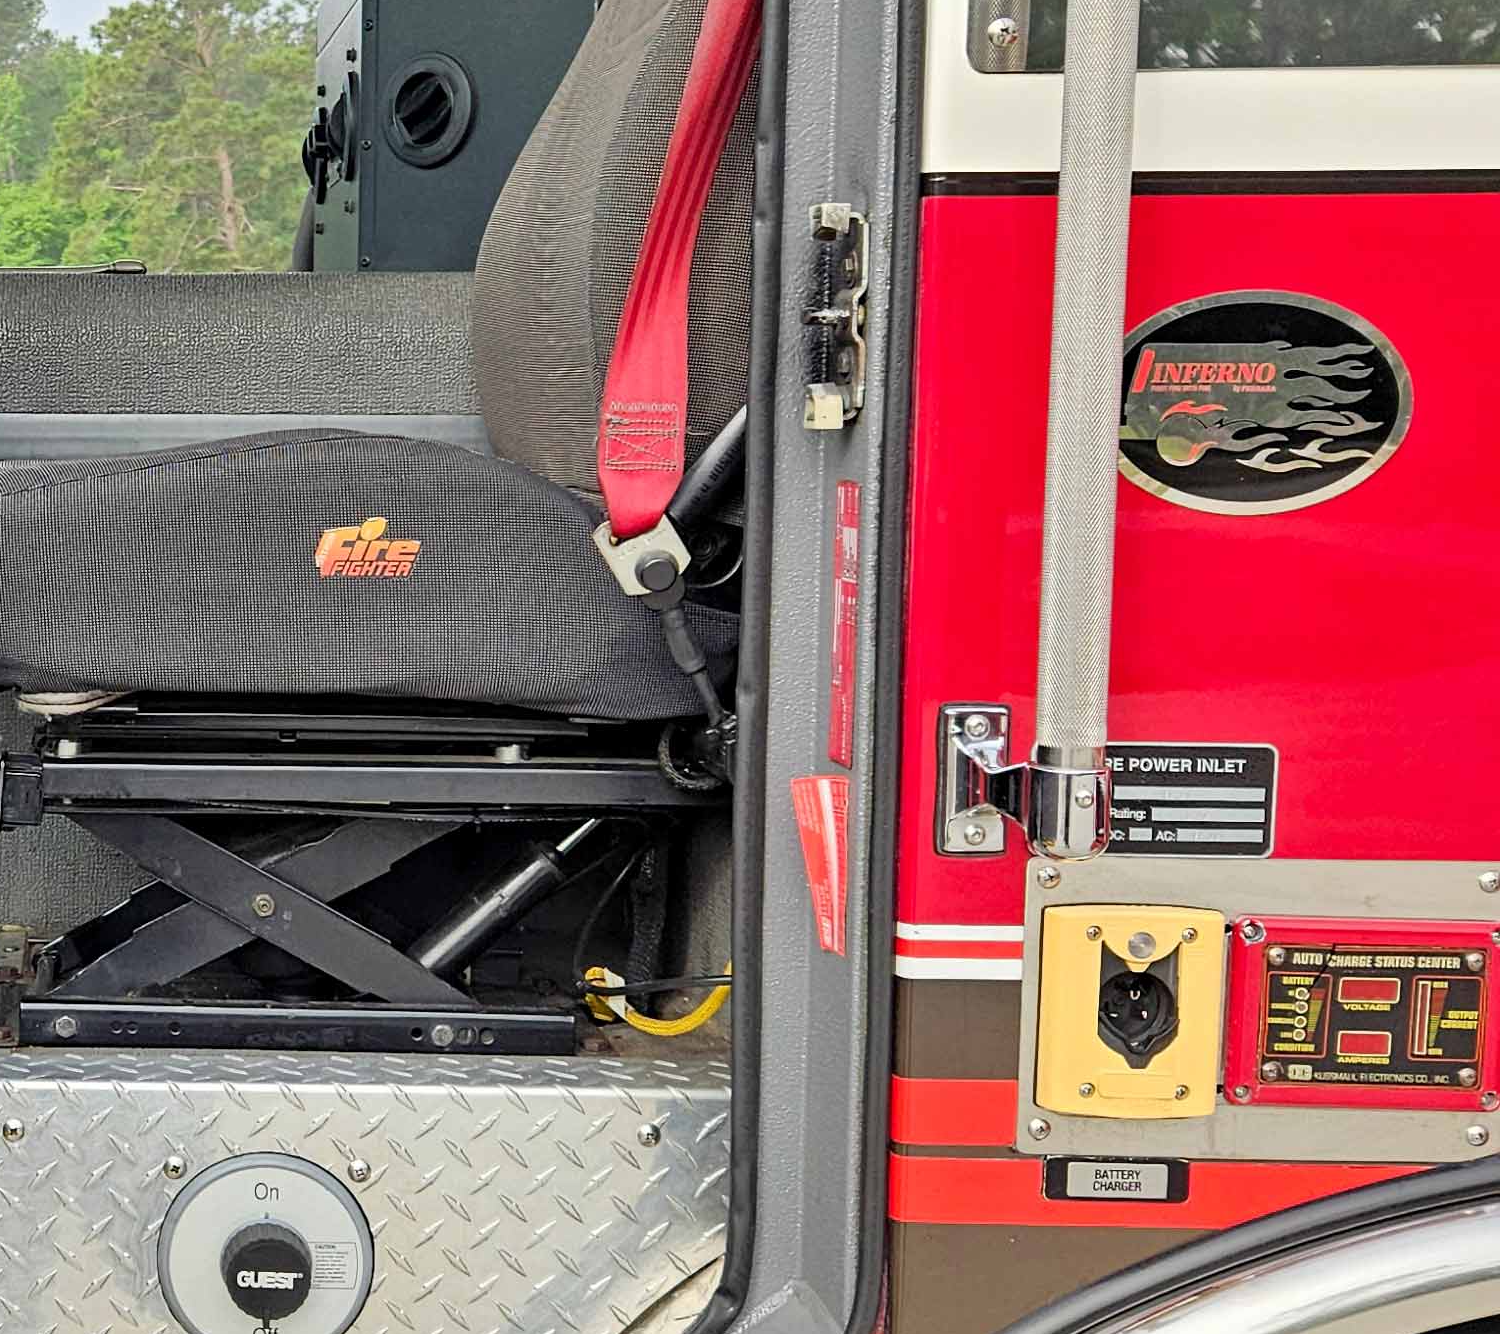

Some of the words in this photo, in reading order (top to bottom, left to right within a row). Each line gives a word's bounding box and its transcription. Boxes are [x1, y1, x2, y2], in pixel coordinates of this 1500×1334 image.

[1150, 362, 1277, 384] INFERNO
[315, 517, 421, 567] Fire
[330, 561, 412, 577] FIGHTER
[1129, 757, 1192, 773] POWER
[1197, 759, 1247, 774] INLET
[1109, 807, 1147, 822] Rating:
[1292, 953, 1323, 965] AUTO
[1374, 956, 1415, 968] STATUS
[1417, 957, 1461, 969] CENTER
[1094, 1169, 1141, 1179] BATTERY
[254, 1183, 279, 1201] On
[1093, 1180, 1142, 1191] CHARGER
[236, 1271, 298, 1291] GUEST
